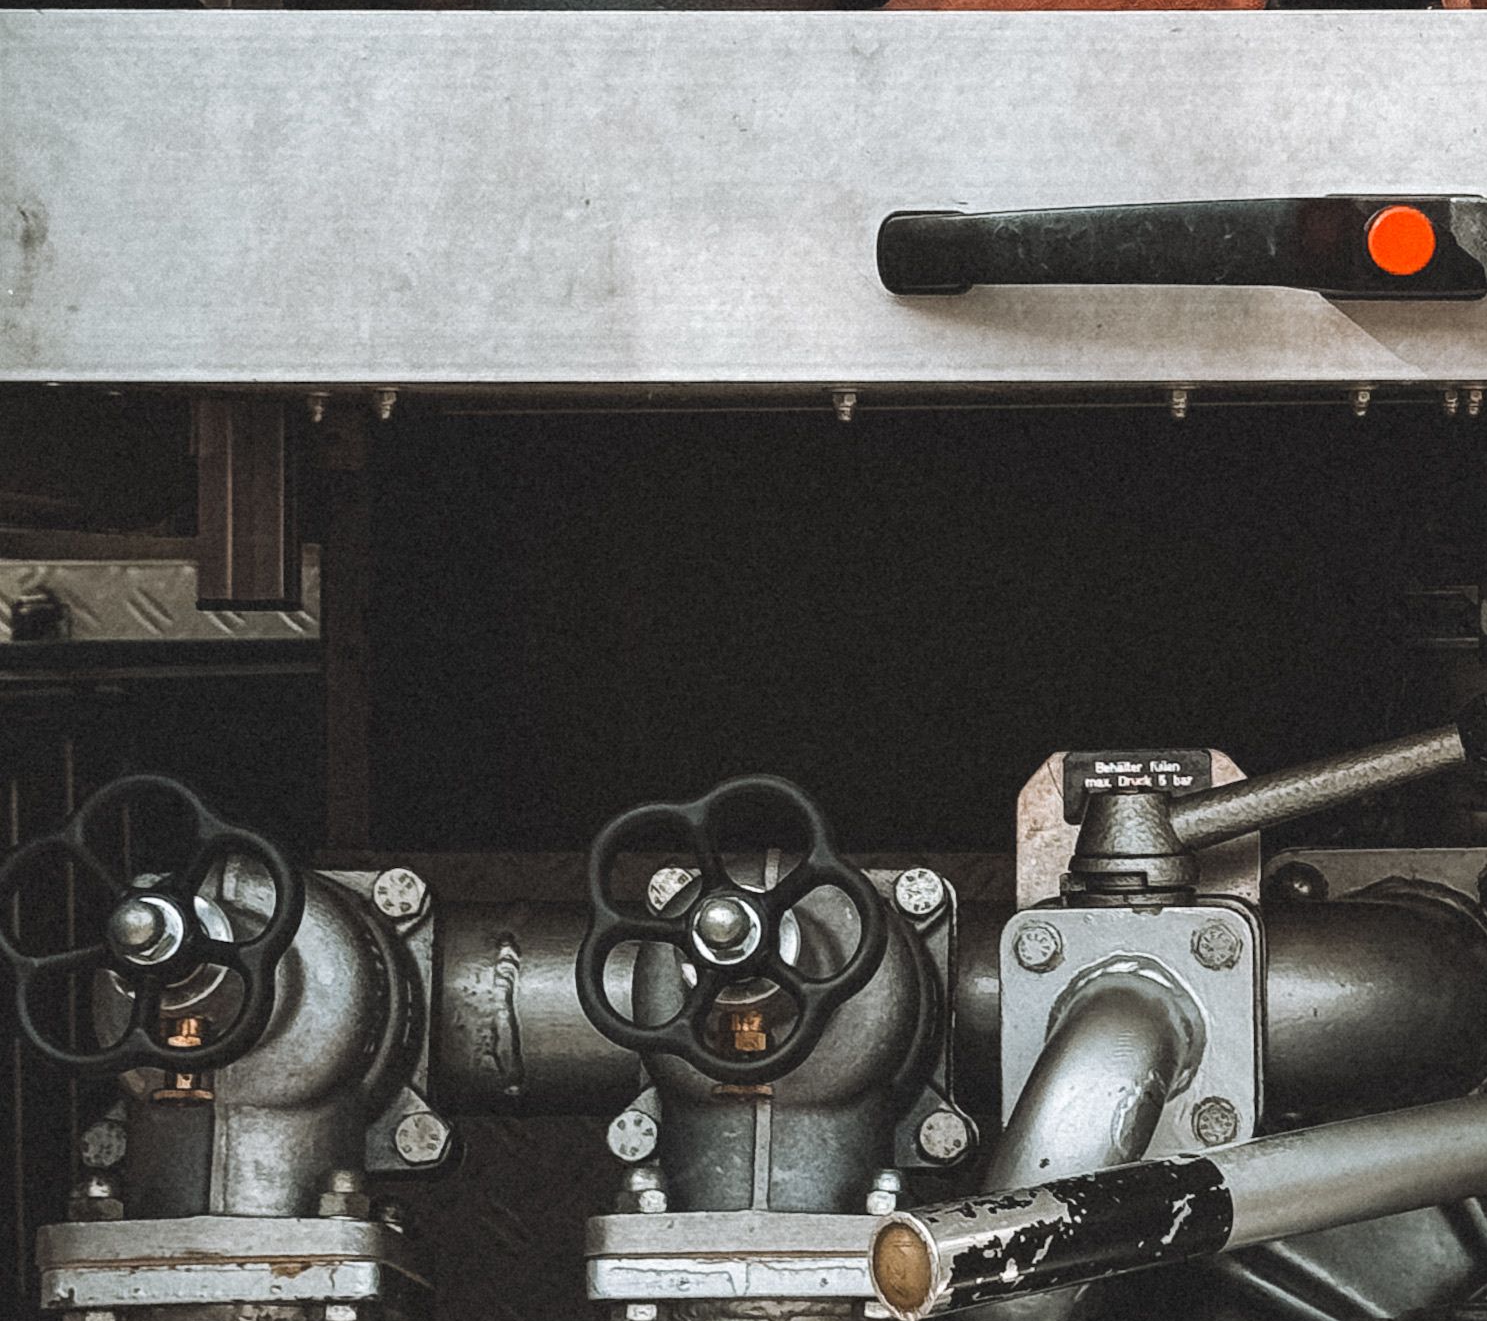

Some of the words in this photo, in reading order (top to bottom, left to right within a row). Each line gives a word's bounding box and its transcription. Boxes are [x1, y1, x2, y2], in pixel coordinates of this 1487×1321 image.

[1094, 761, 1143, 774] Behälter
[1118, 776, 1152, 788] Druck
[1173, 775, 1194, 787] bar
